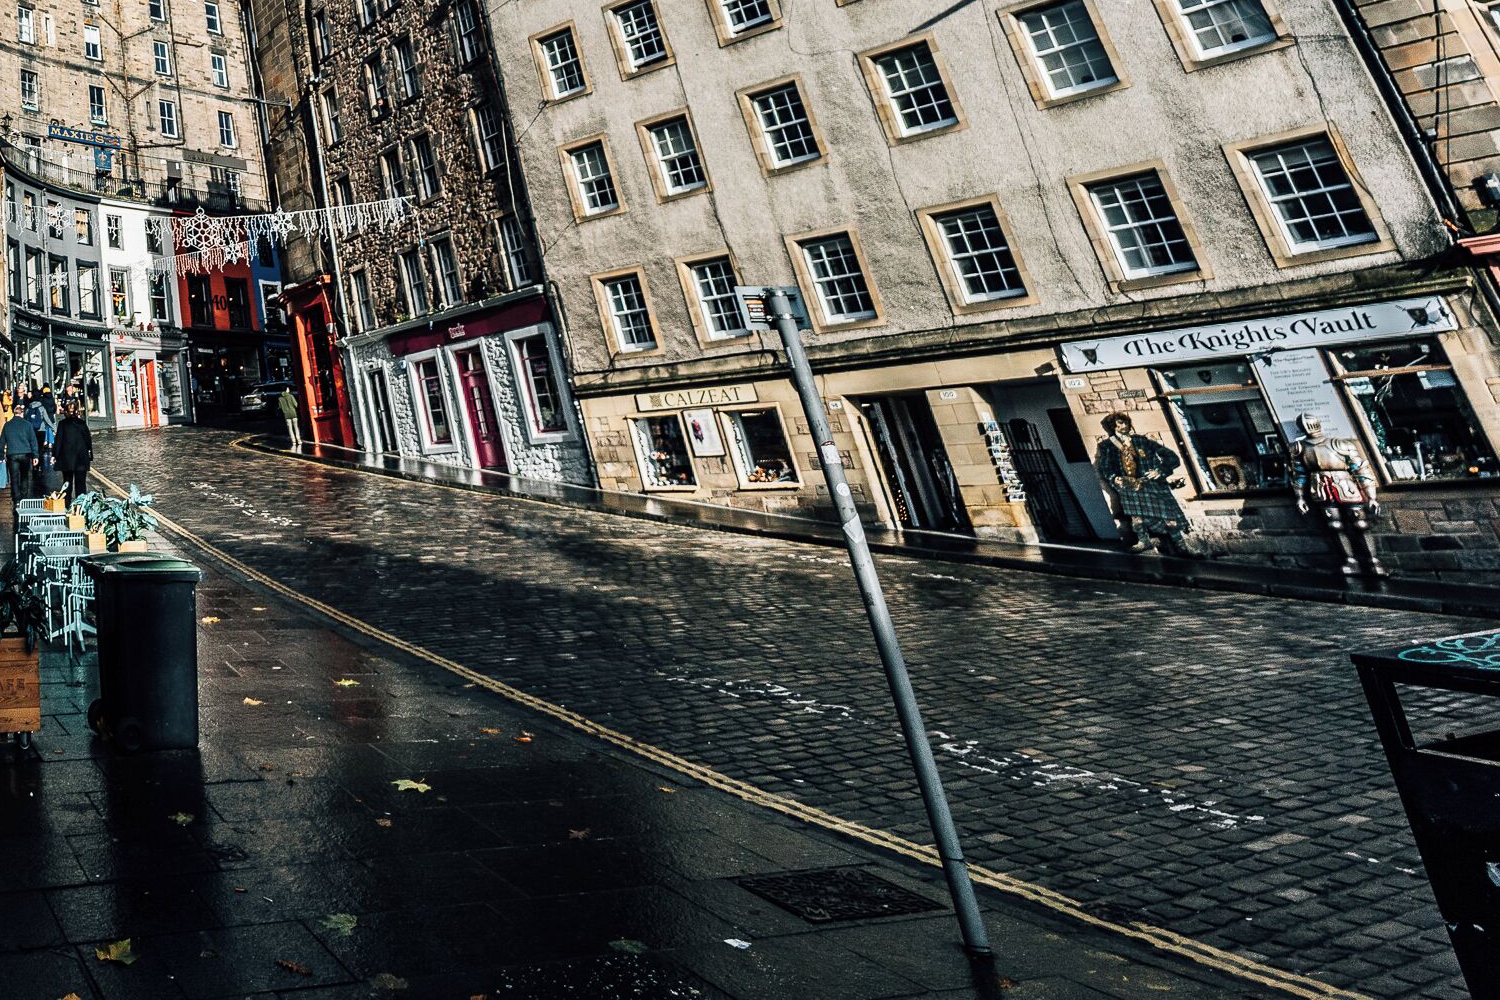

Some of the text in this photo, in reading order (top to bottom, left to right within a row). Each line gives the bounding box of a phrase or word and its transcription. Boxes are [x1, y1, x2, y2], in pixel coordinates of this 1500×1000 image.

[50, 126, 105, 144] MAXIES
[212, 294, 228, 311] 40
[1123, 309, 1378, 357] The Knights Vault
[664, 386, 741, 407] CALZEAT
